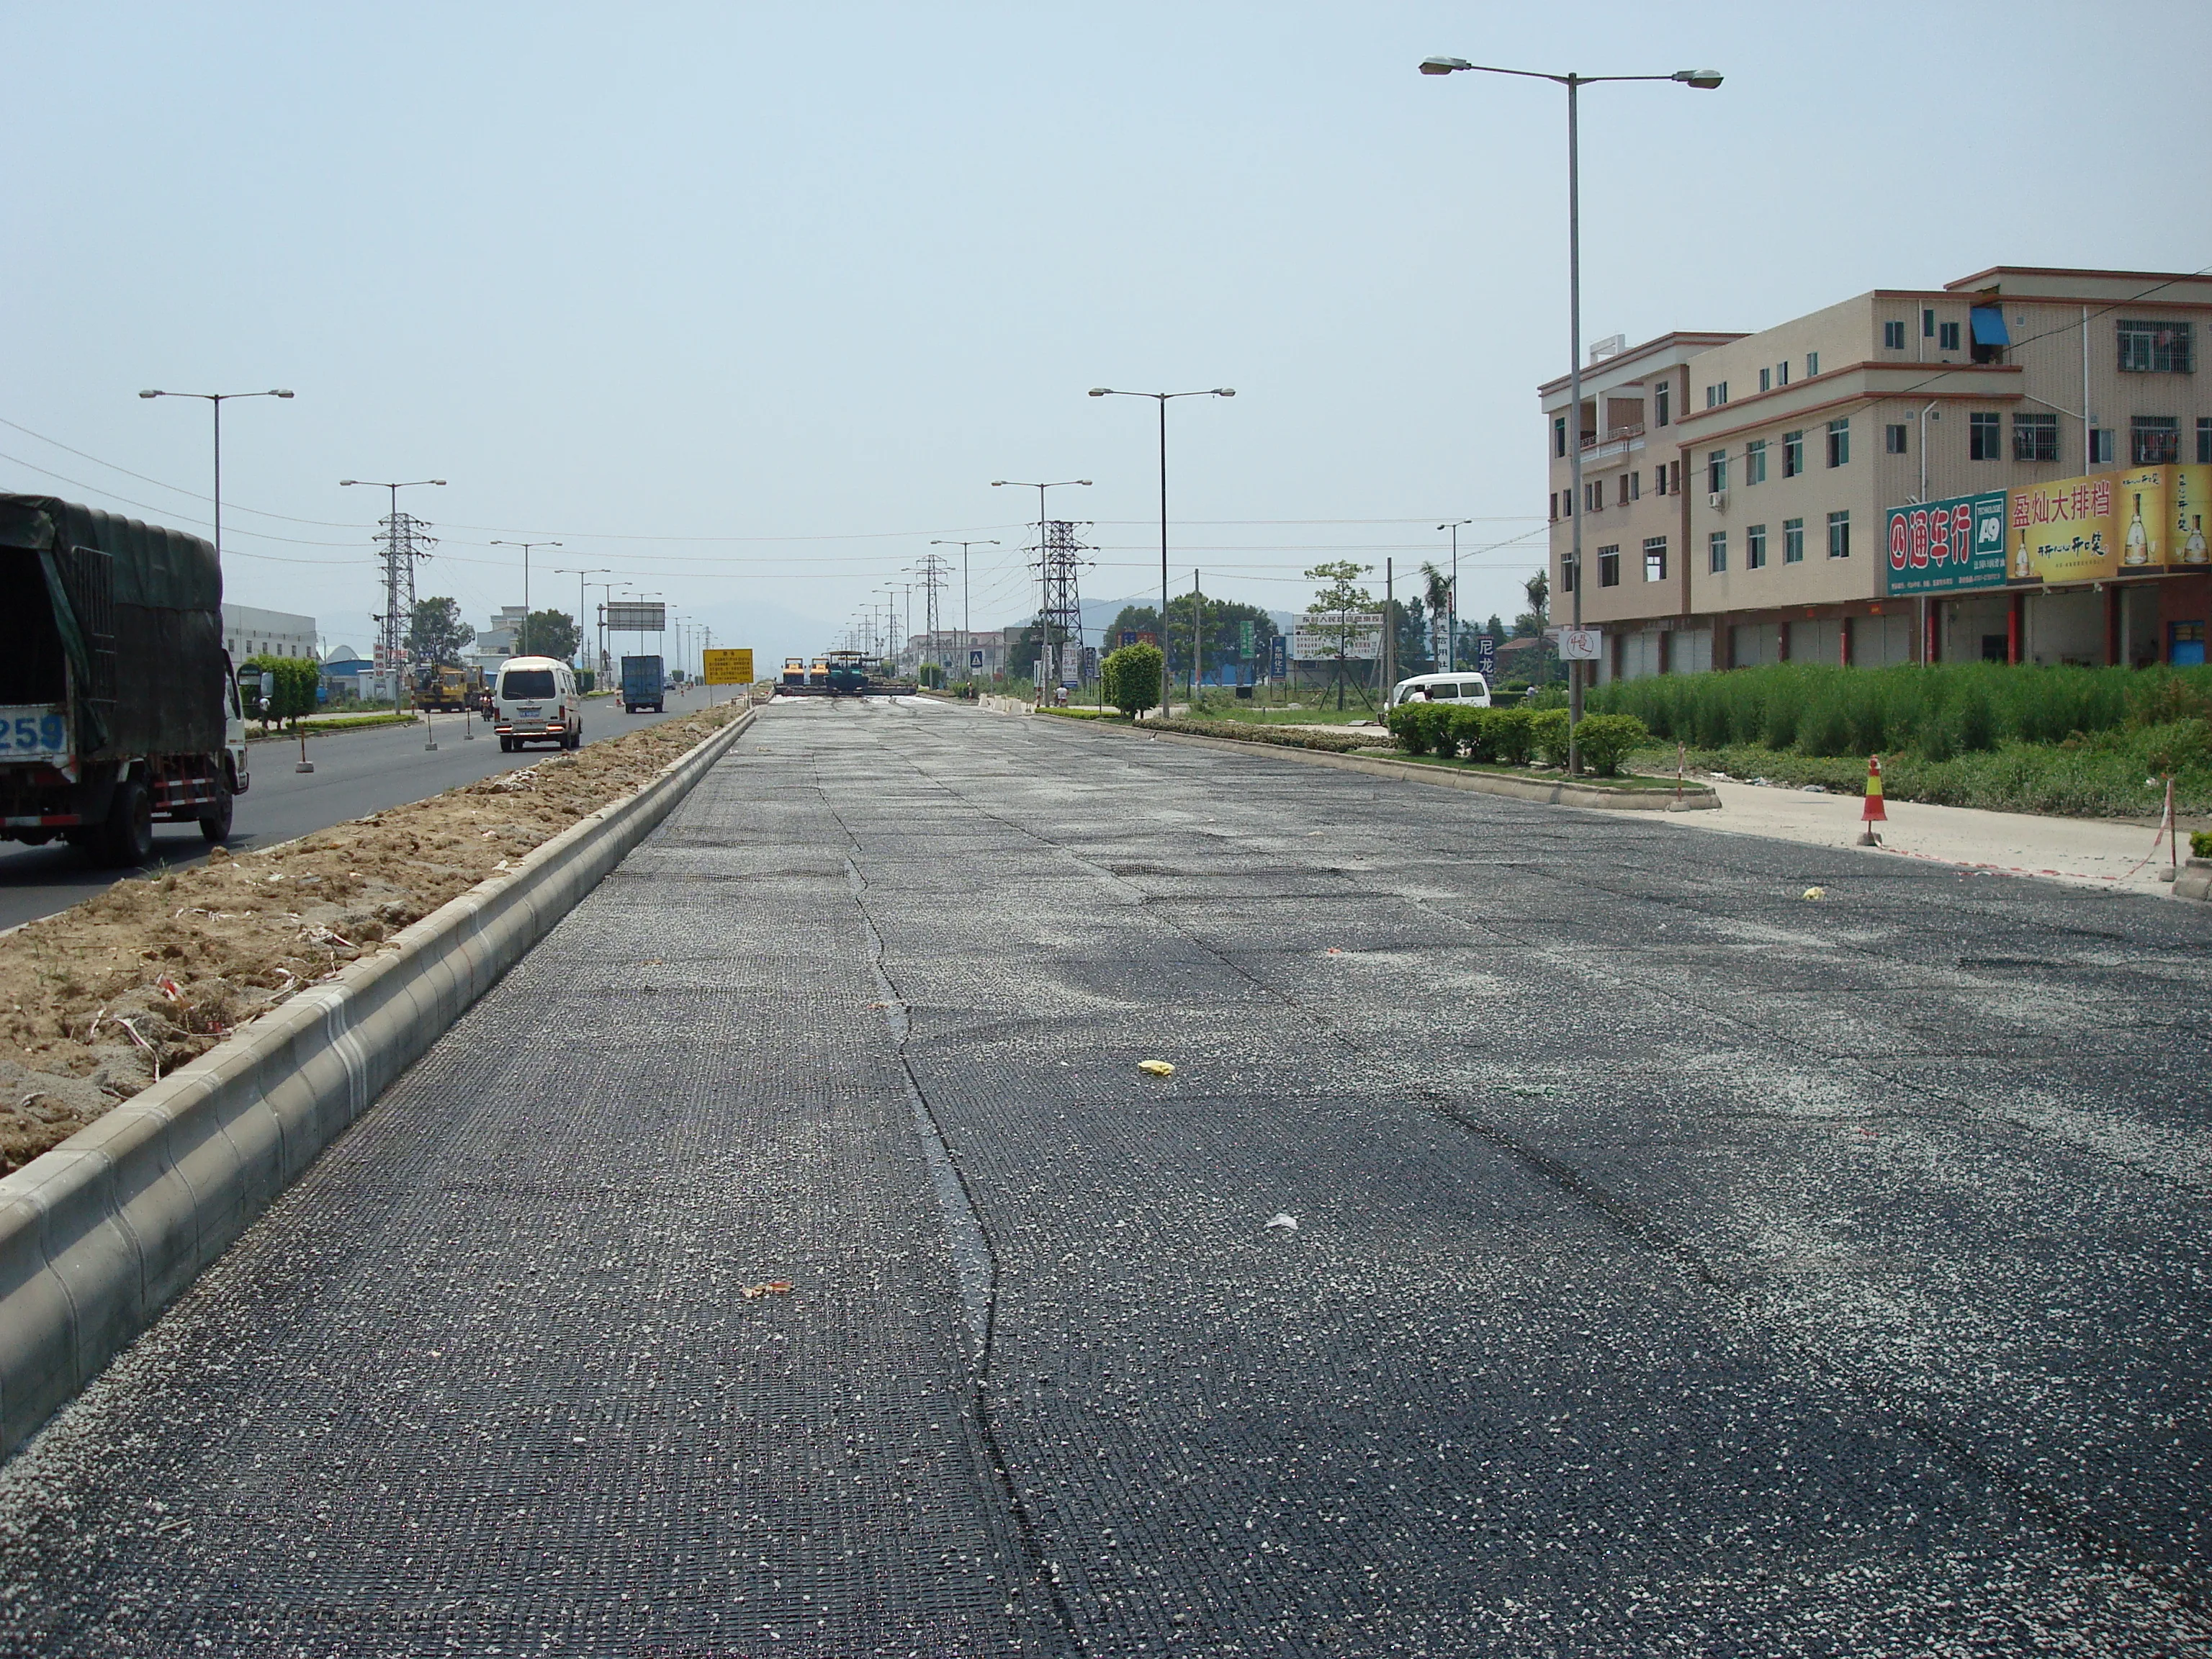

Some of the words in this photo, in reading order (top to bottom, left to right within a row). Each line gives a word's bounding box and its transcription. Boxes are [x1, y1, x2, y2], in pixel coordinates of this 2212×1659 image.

[2013, 480, 2110, 529] 盈灿大排档
[1889, 503, 1972, 571] 四通车行
[1978, 517, 2000, 544] A9
[1480, 639, 1493, 674] 尼龙
[1570, 634, 1593, 652] 慢
